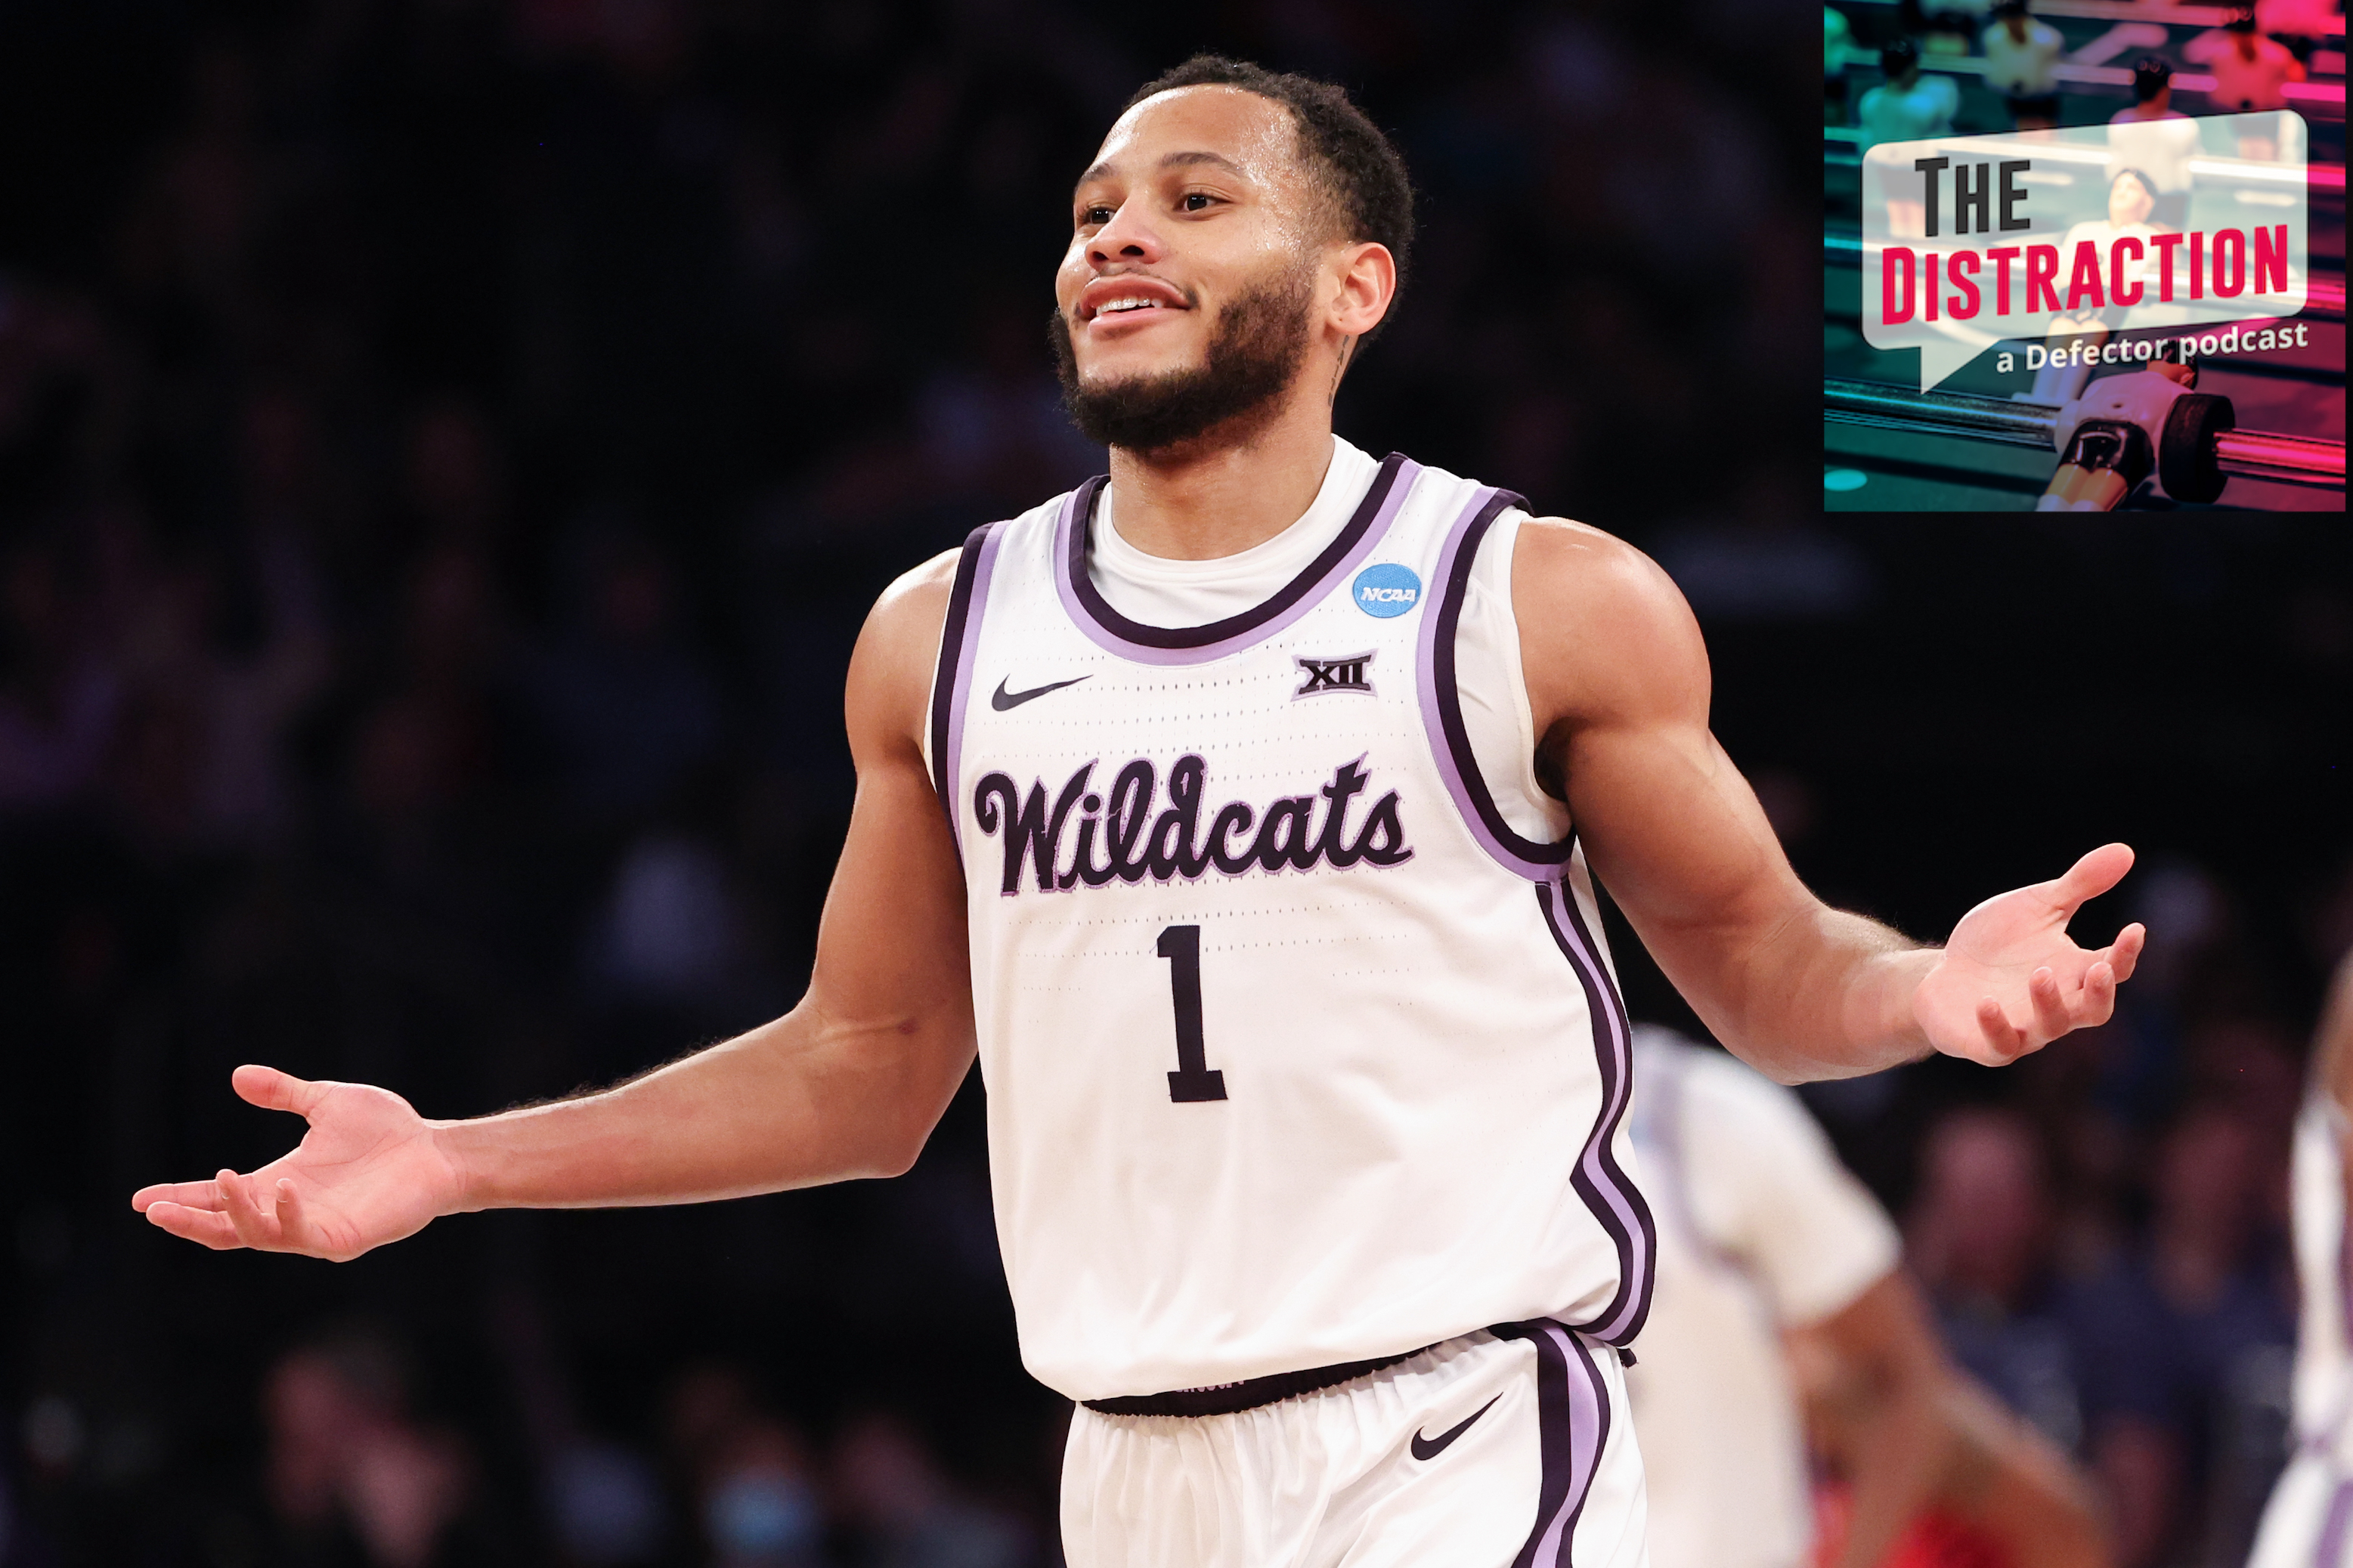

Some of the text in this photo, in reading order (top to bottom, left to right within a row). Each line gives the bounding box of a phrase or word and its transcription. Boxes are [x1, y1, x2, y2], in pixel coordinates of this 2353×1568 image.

[1361, 586, 1416, 602] NCAA
[1296, 653, 1373, 696] XII
[974, 752, 1415, 895] Wildcats
[1156, 925, 1228, 1103] 1
